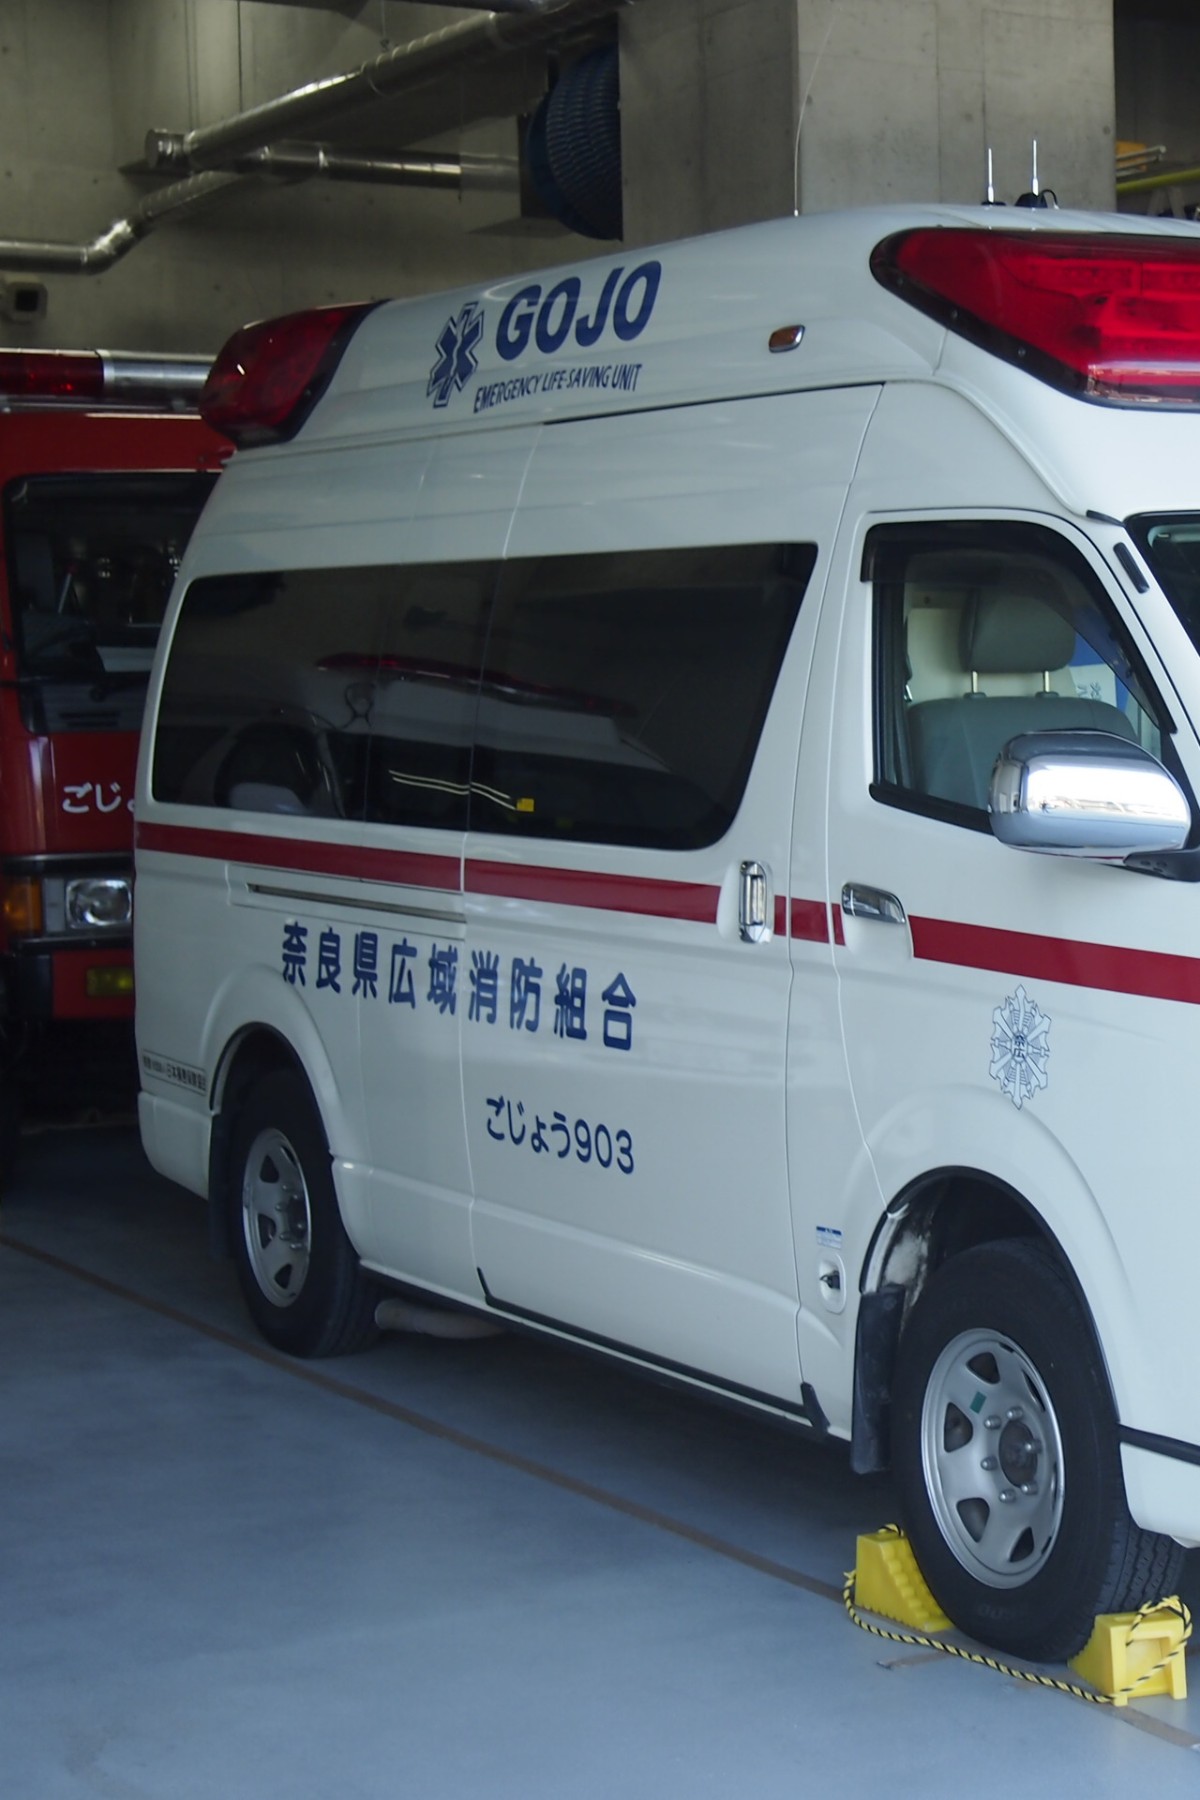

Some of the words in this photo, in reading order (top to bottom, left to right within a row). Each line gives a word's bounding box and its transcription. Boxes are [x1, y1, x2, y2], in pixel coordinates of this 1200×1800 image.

[496, 260, 661, 361] GOJO
[473, 375, 541, 413] EMERGENCY
[541, 365, 611, 393] LIFE-SAVING
[611, 363, 643, 392] UNIT
[282, 920, 637, 1051] 奈良県広域消防組合
[486, 1094, 635, 1175] ごじょう903
